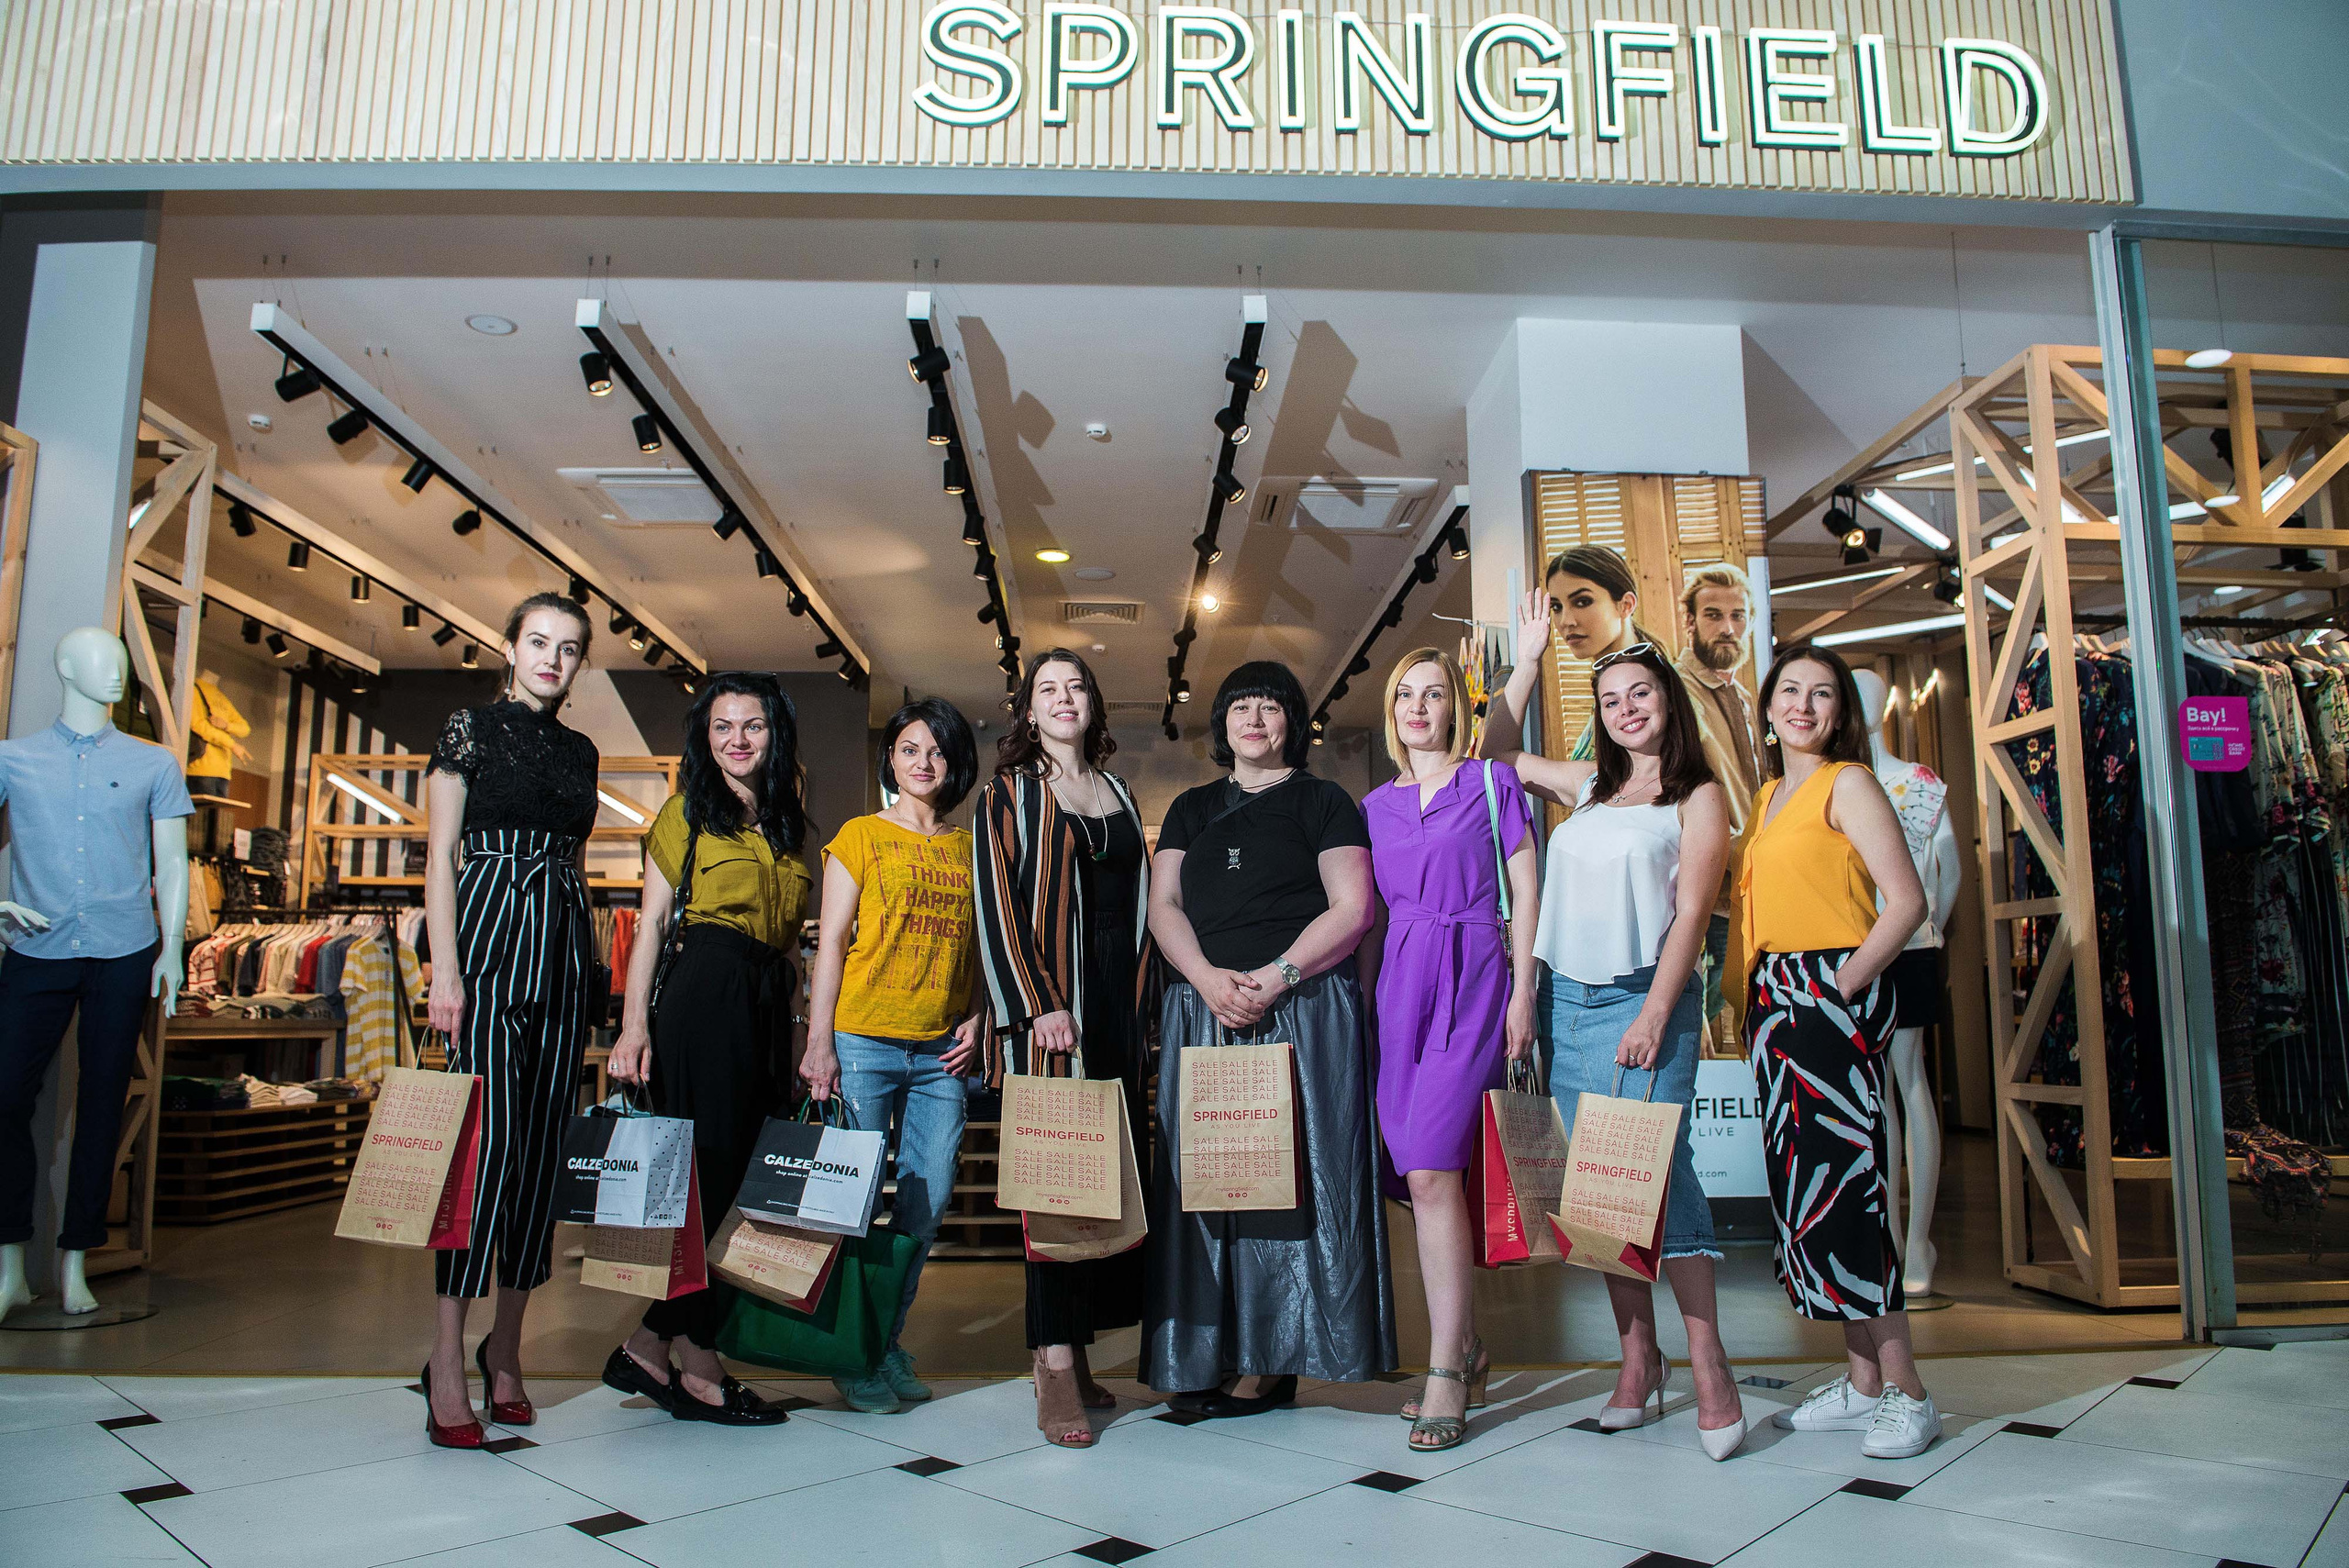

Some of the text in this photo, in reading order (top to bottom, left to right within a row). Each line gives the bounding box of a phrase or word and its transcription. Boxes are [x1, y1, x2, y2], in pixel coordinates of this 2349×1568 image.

[912, 0, 2048, 158] SPRINGFIELD
[2187, 707, 2226, 726] Bay!
[907, 864, 969, 889] THINK
[906, 887, 968, 914] HAPPY
[901, 914, 968, 940] THINGS
[387, 1084, 462, 1097] SALE SALE SALE
[1078, 1092, 1105, 1100] SALE
[385, 1092, 459, 1106] SALE SALE SALE
[1078, 1099, 1105, 1107] SALE
[383, 1101, 455, 1115] SALE SALE SALE
[1017, 1107, 1043, 1116] SALE
[1078, 1106, 1105, 1114] SALE
[1194, 1108, 1277, 1121] SPRINGFIELD
[380, 1109, 453, 1123] SALE SALE SALE
[1017, 1114, 1043, 1122] SALE
[1585, 1110, 1664, 1127] SALE SALE SALE
[377, 1118, 450, 1131] SALE SALE SALE
[1583, 1118, 1663, 1135] SALE SALE SALE
[1016, 1127, 1105, 1142] SPRINGFIELD
[1581, 1127, 1660, 1144] SALE SALE SALE
[1698, 1128, 1734, 1137] LIVE
[372, 1134, 442, 1151] SPRINGFIELD
[1580, 1136, 1658, 1153] SALE SALE SALE
[1579, 1145, 1656, 1162] SALE SALE SALE
[365, 1162, 436, 1175] SALE SALE SALE
[567, 1157, 639, 1172] CALZEDONIA
[764, 1154, 859, 1177] CALZEDONIA
[1513, 1156, 1566, 1168] SPRINGFIELD
[362, 1171, 433, 1184] SALE SALE SALE
[809, 1174, 843, 1184] calzedonia.com
[1576, 1161, 1652, 1182] SPRINGFIELD
[360, 1179, 431, 1195] SALE SALE SALE
[358, 1188, 429, 1203] SALE SALE SALE
[355, 1196, 427, 1212] SALE SALE SALE
